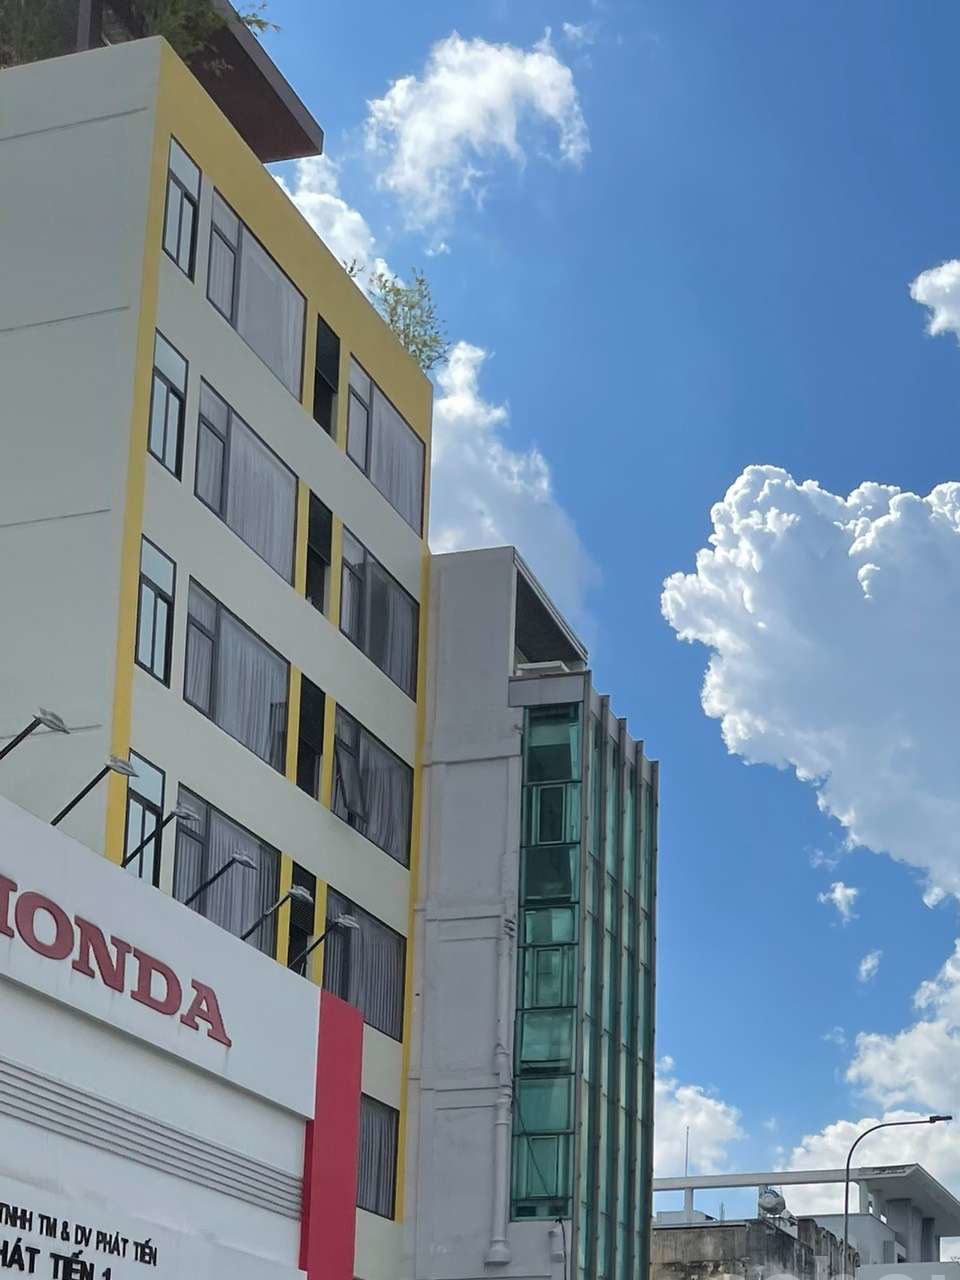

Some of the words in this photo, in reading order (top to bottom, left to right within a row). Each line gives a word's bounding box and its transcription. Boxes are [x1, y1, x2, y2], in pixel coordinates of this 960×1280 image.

[38, 1213, 57, 1238] TM
[61, 1220, 70, 1241] &
[74, 1224, 92, 1247] DV
[95, 1231, 129, 1258] PHÁT
